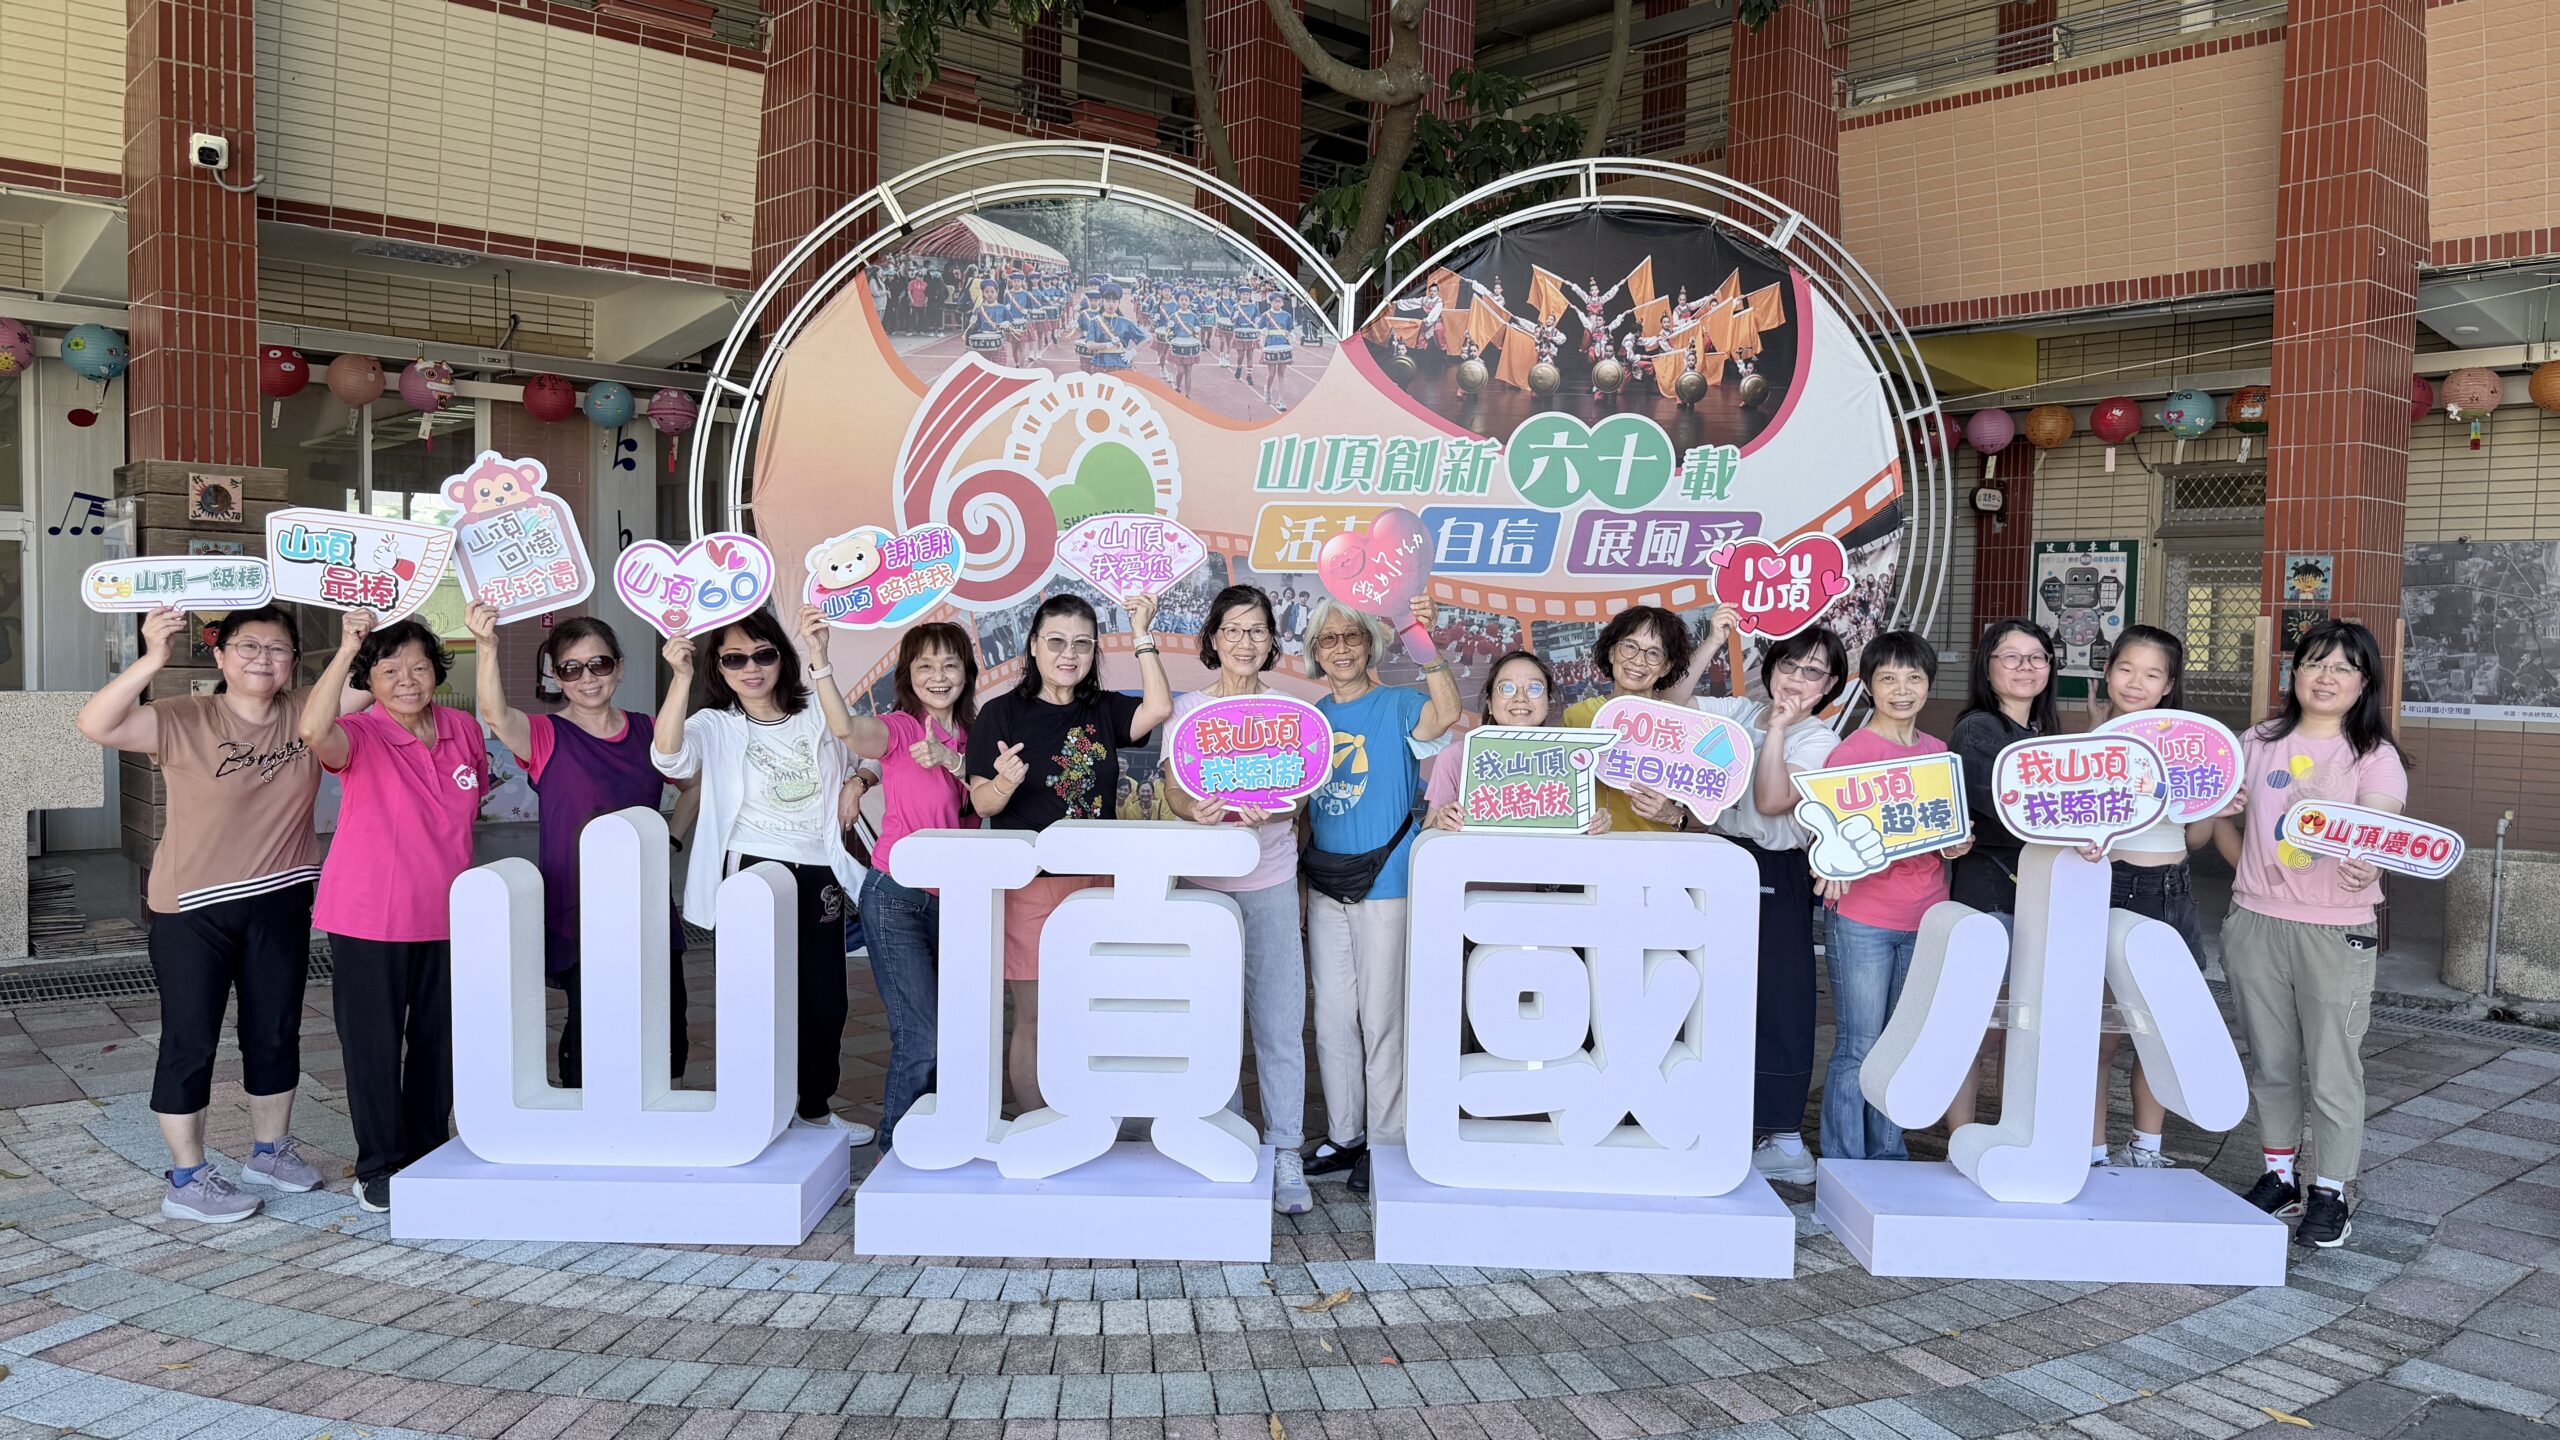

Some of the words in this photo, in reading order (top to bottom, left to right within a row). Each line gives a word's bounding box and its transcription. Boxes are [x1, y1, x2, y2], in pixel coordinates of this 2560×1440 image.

[1256, 431, 1740, 500] 山頂創新六十載
[278, 525, 354, 566] 山頂
[467, 510, 523, 554] 山頂
[498, 528, 559, 572] 回憶
[884, 528, 953, 568] 謝謝
[1099, 521, 1165, 552] 山頂
[1436, 517, 1541, 566] 自信
[135, 565, 261, 592] 山頂一級棒
[323, 566, 395, 607] 最棒
[481, 560, 578, 605] 好珍貴
[623, 560, 758, 609] 山頂60
[1090, 553, 1174, 581] 我愛您
[821, 586, 872, 618] 山頂
[878, 564, 955, 603] 陪伴我
[1742, 578, 1811, 612] 山頂
[1196, 714, 1301, 754] 我山頂
[1612, 710, 1686, 751] 60歲
[1201, 751, 1305, 792] 我驕傲
[1473, 747, 1567, 780] 我山頂
[1606, 750, 1728, 799] 生日快樂
[2017, 746, 2129, 785] 我山頂
[1470, 782, 1575, 820] 我驕傲
[1836, 766, 1916, 811] 山頂
[2023, 787, 2136, 827] 我驕傲
[1882, 798, 1952, 834] 超棒
[2322, 819, 2451, 862] 山頂慶60
